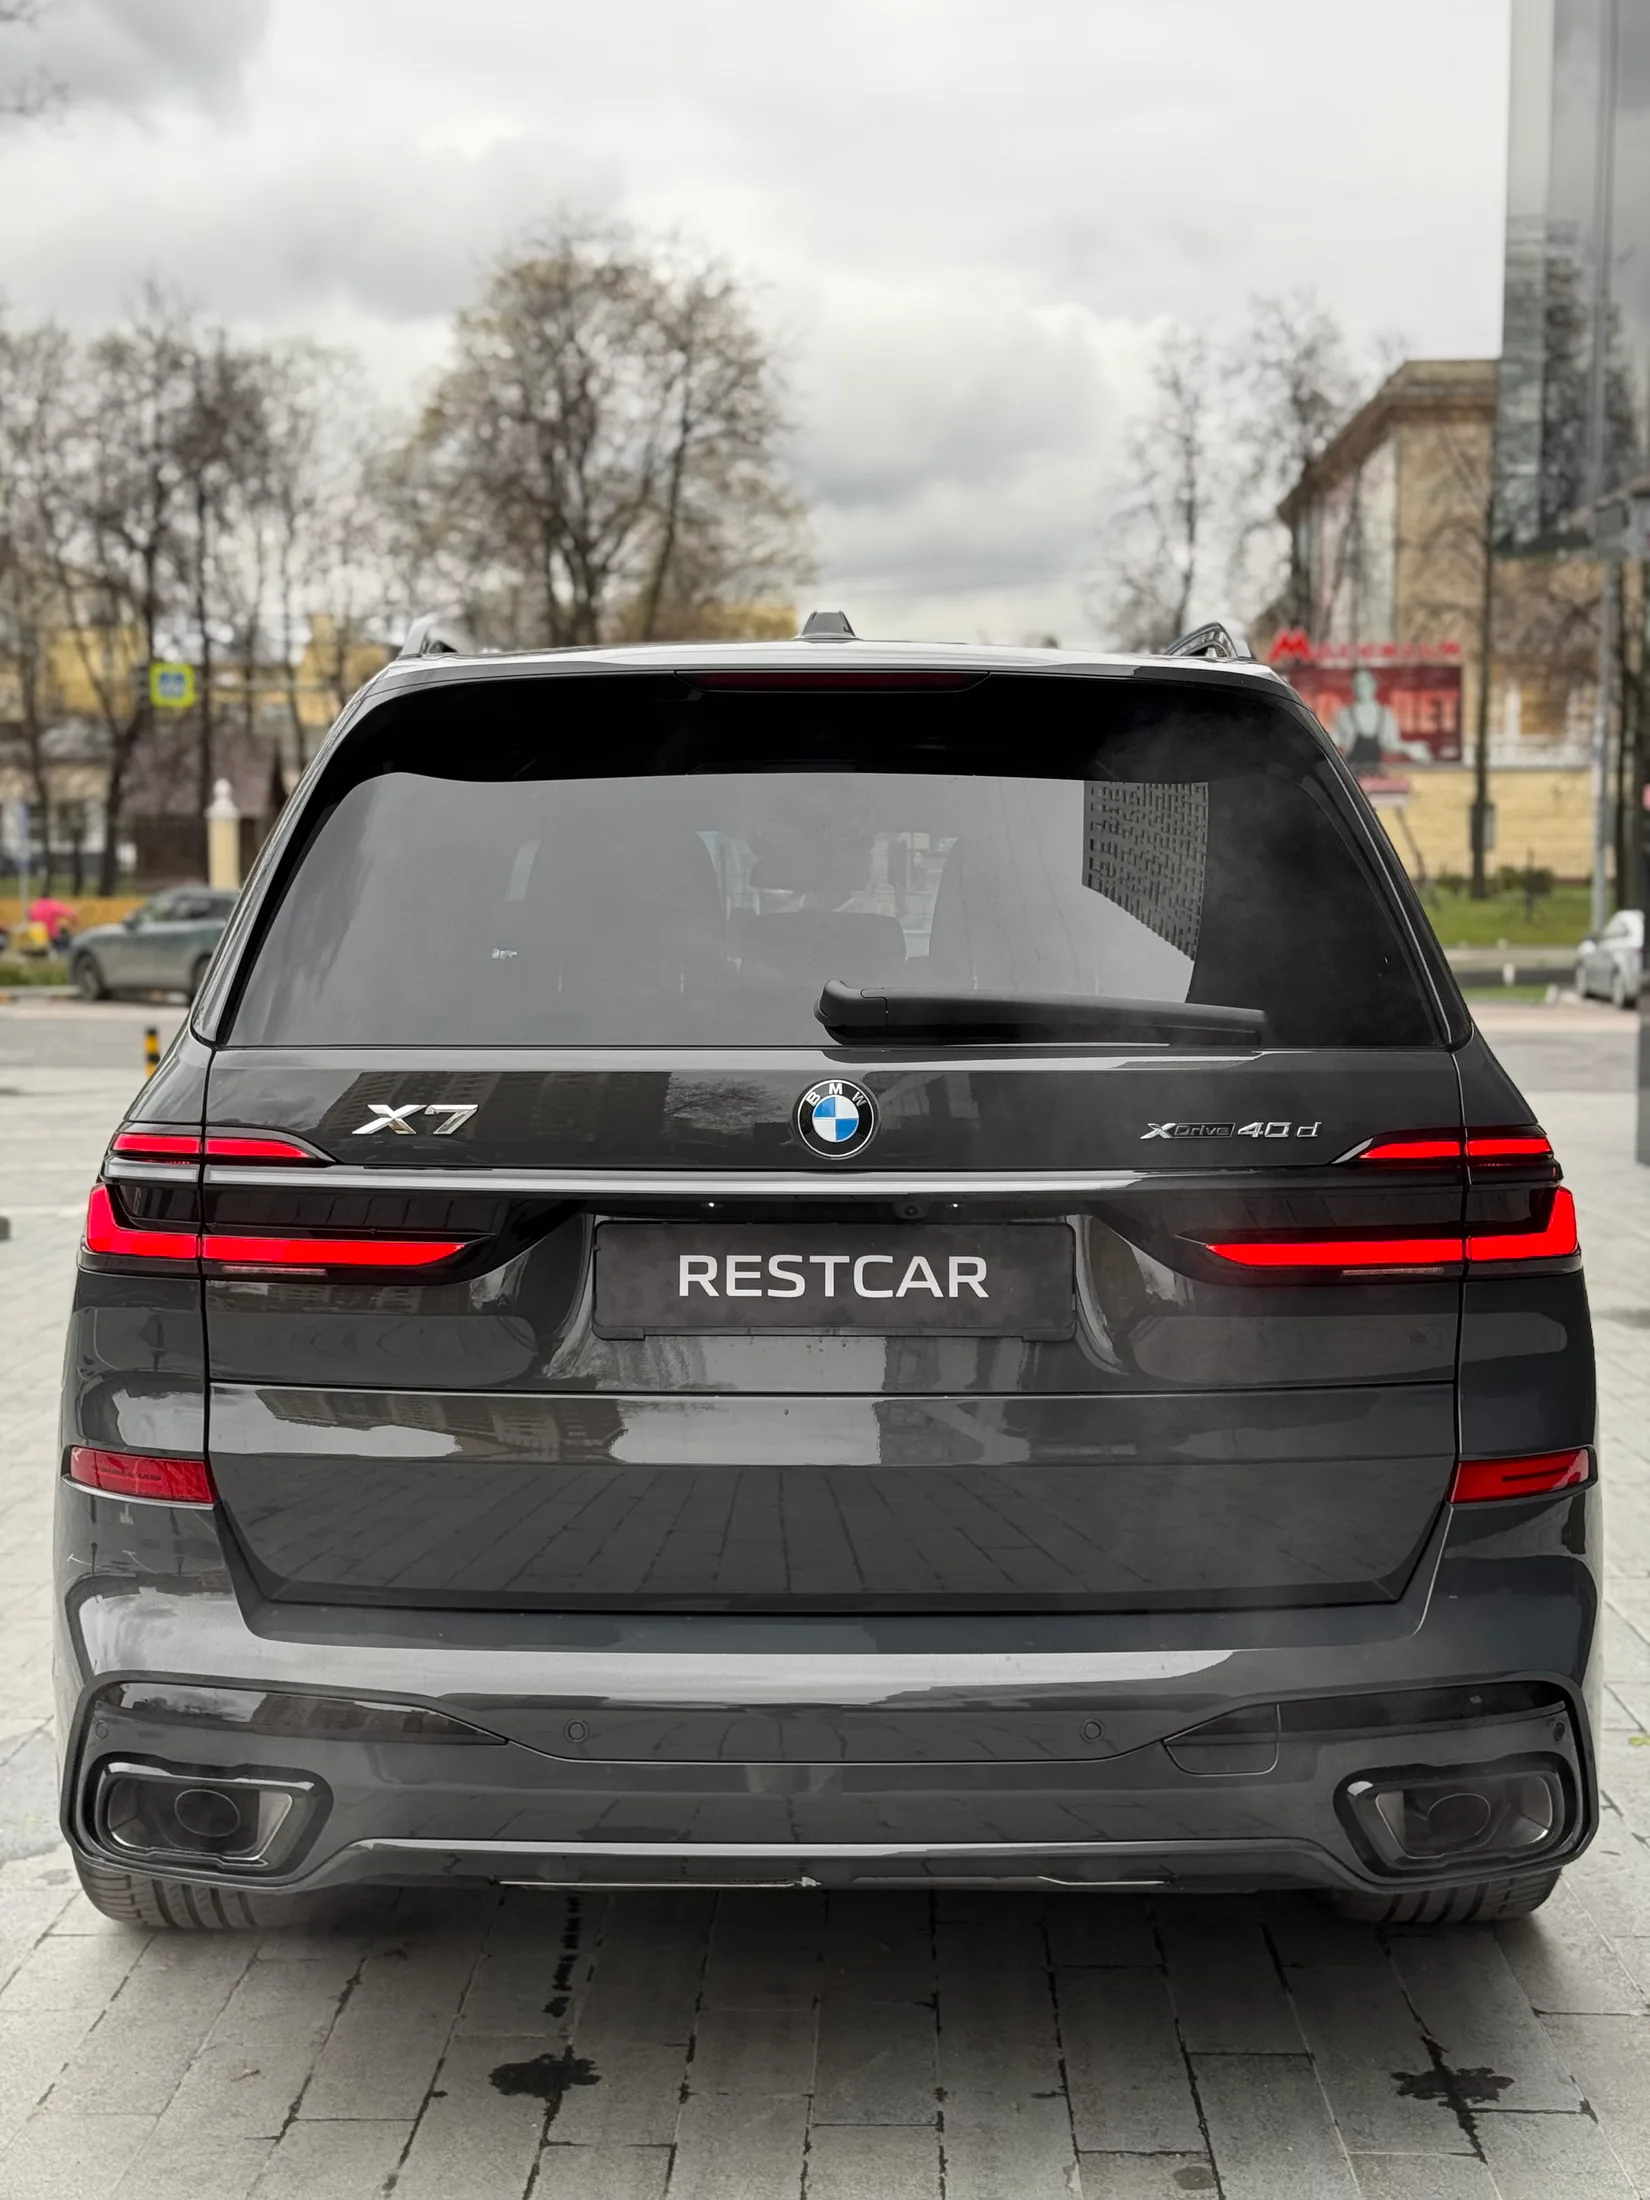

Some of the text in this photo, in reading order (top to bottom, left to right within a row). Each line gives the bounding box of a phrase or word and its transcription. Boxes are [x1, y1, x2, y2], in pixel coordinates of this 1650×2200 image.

[805, 1082, 867, 1107] BMW
[352, 1104, 478, 1135] X7
[679, 1254, 990, 1299] RESTCAR
